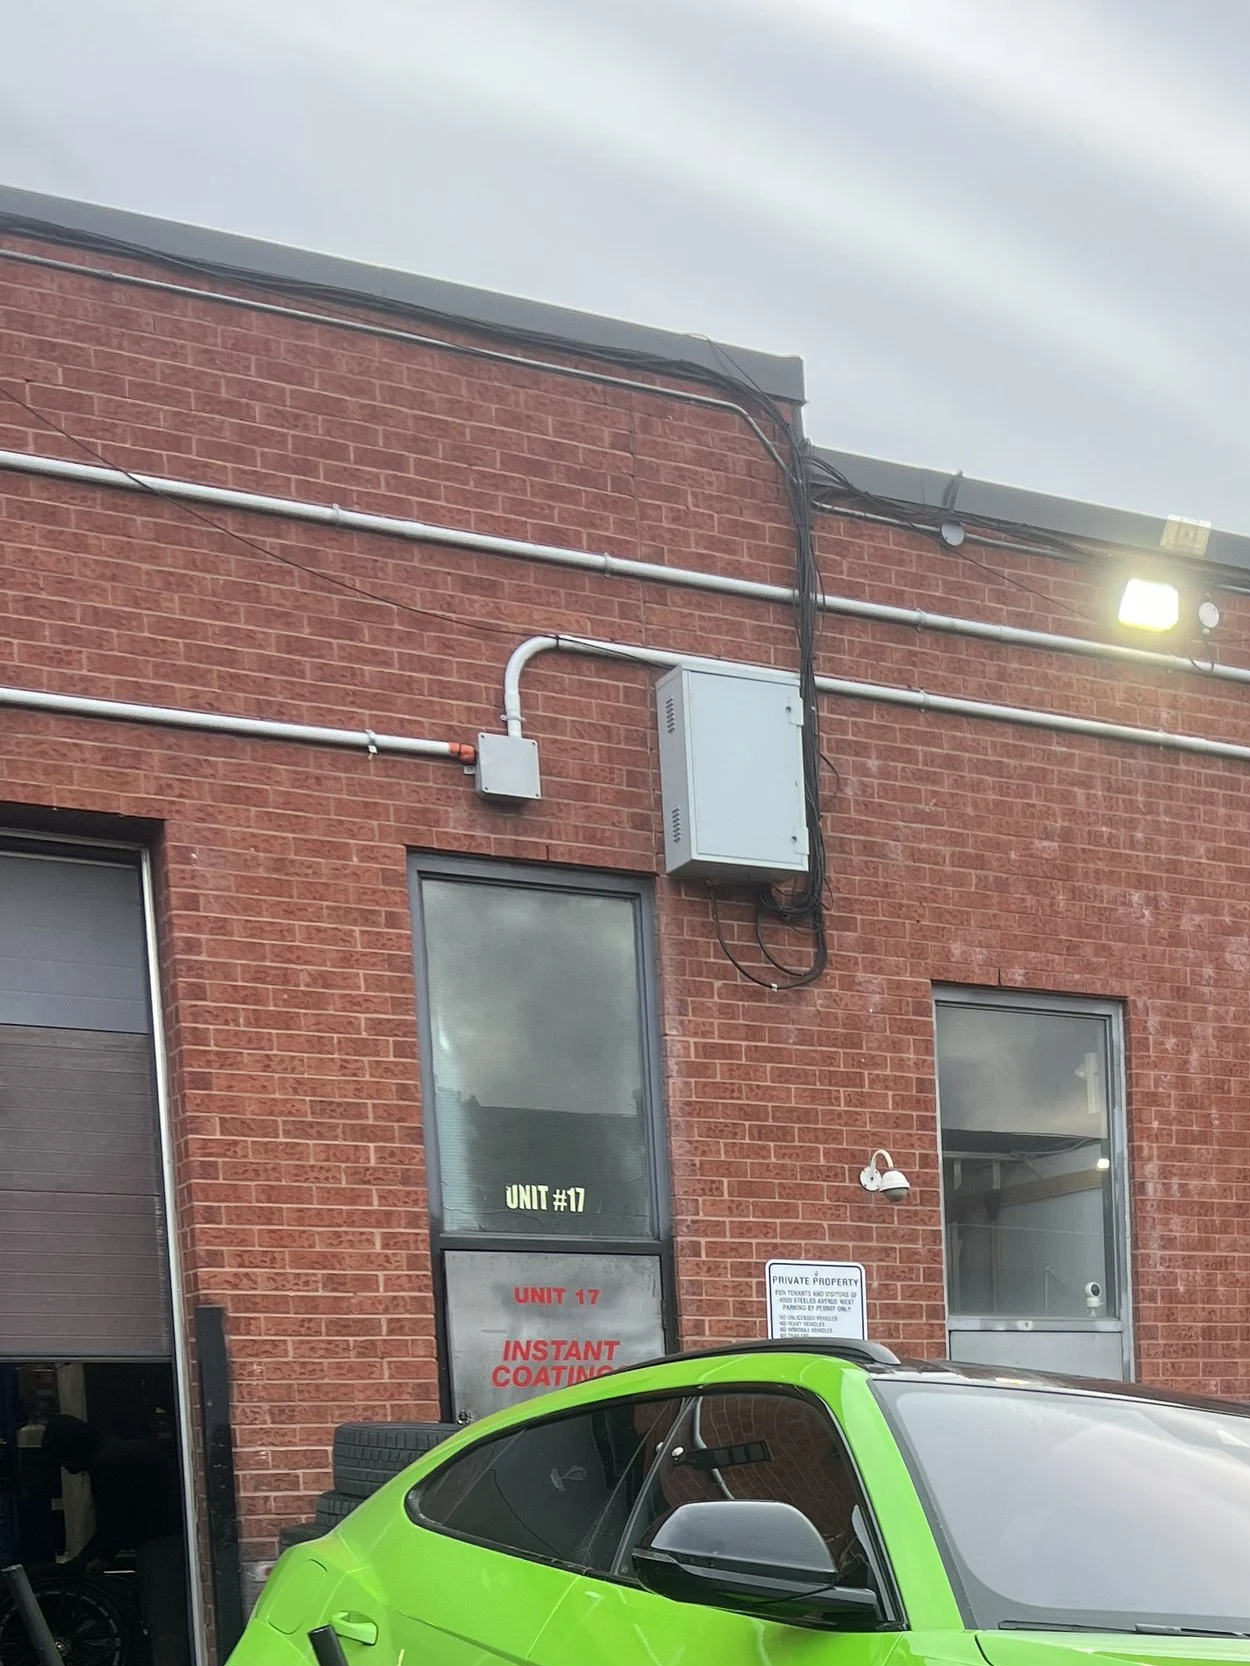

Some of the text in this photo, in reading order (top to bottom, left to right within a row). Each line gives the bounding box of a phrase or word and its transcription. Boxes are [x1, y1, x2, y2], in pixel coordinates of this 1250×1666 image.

[505, 1184, 585, 1213] UNIT #17
[772, 1276, 859, 1287] PRIVATE PROPERTY
[513, 1286, 600, 1305] UNIT 17
[502, 1340, 620, 1362] INSTANT
